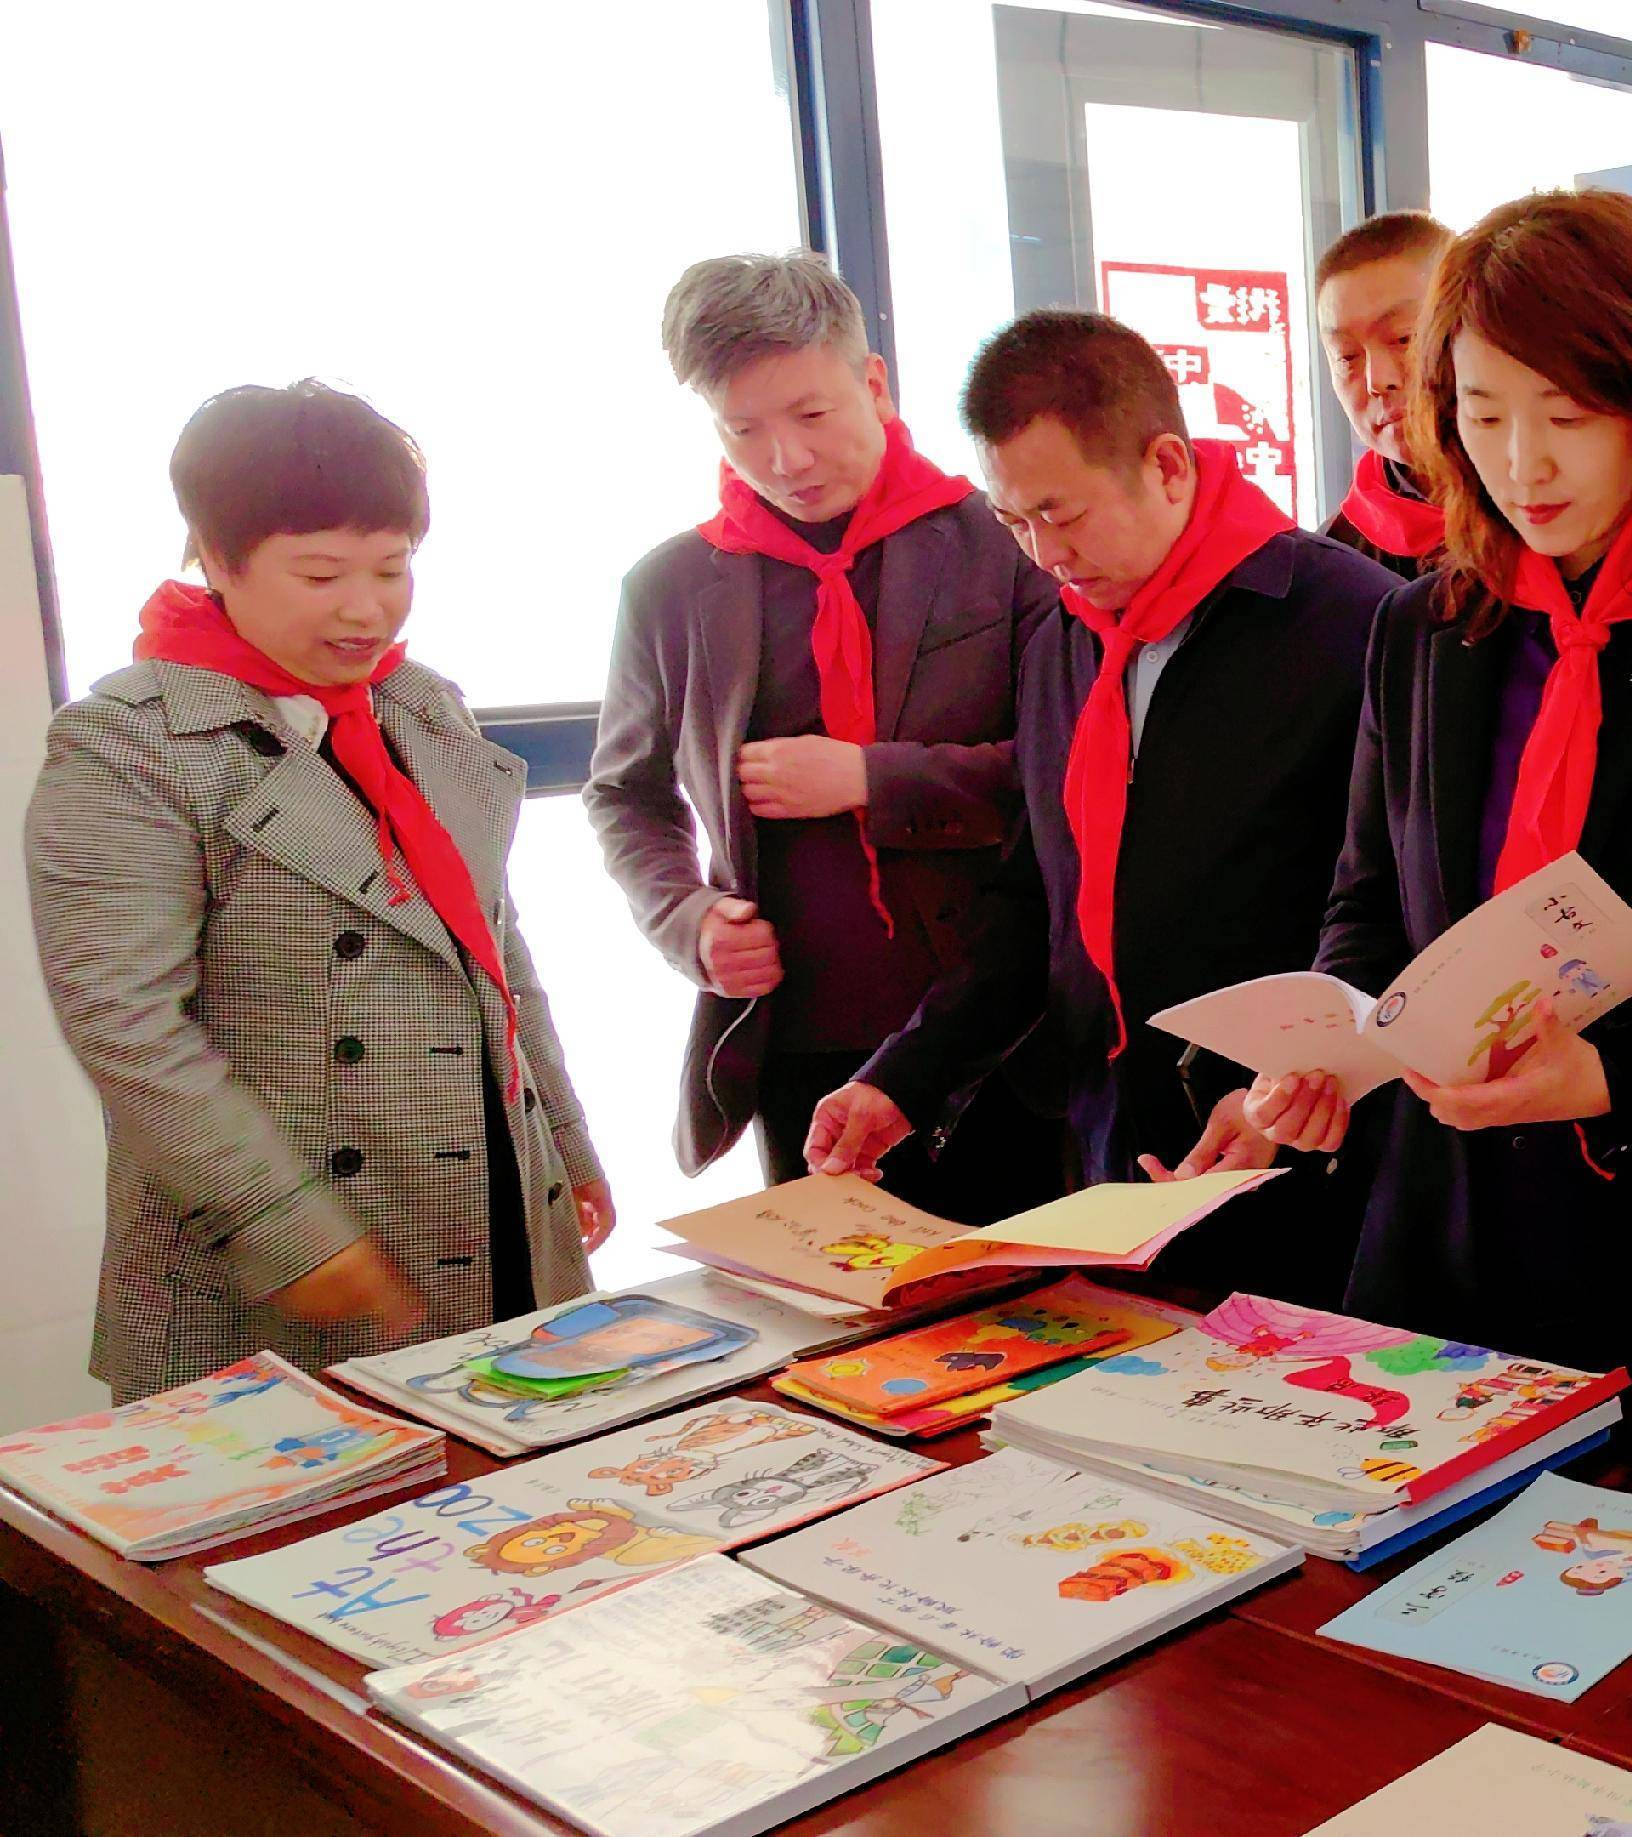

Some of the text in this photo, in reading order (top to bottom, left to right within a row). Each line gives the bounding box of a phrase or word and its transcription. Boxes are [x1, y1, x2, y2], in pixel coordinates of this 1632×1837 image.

[1178, 1386, 1423, 1442] 那些年那些事
[343, 1515, 456, 1575] the
[292, 1563, 432, 1620] At
